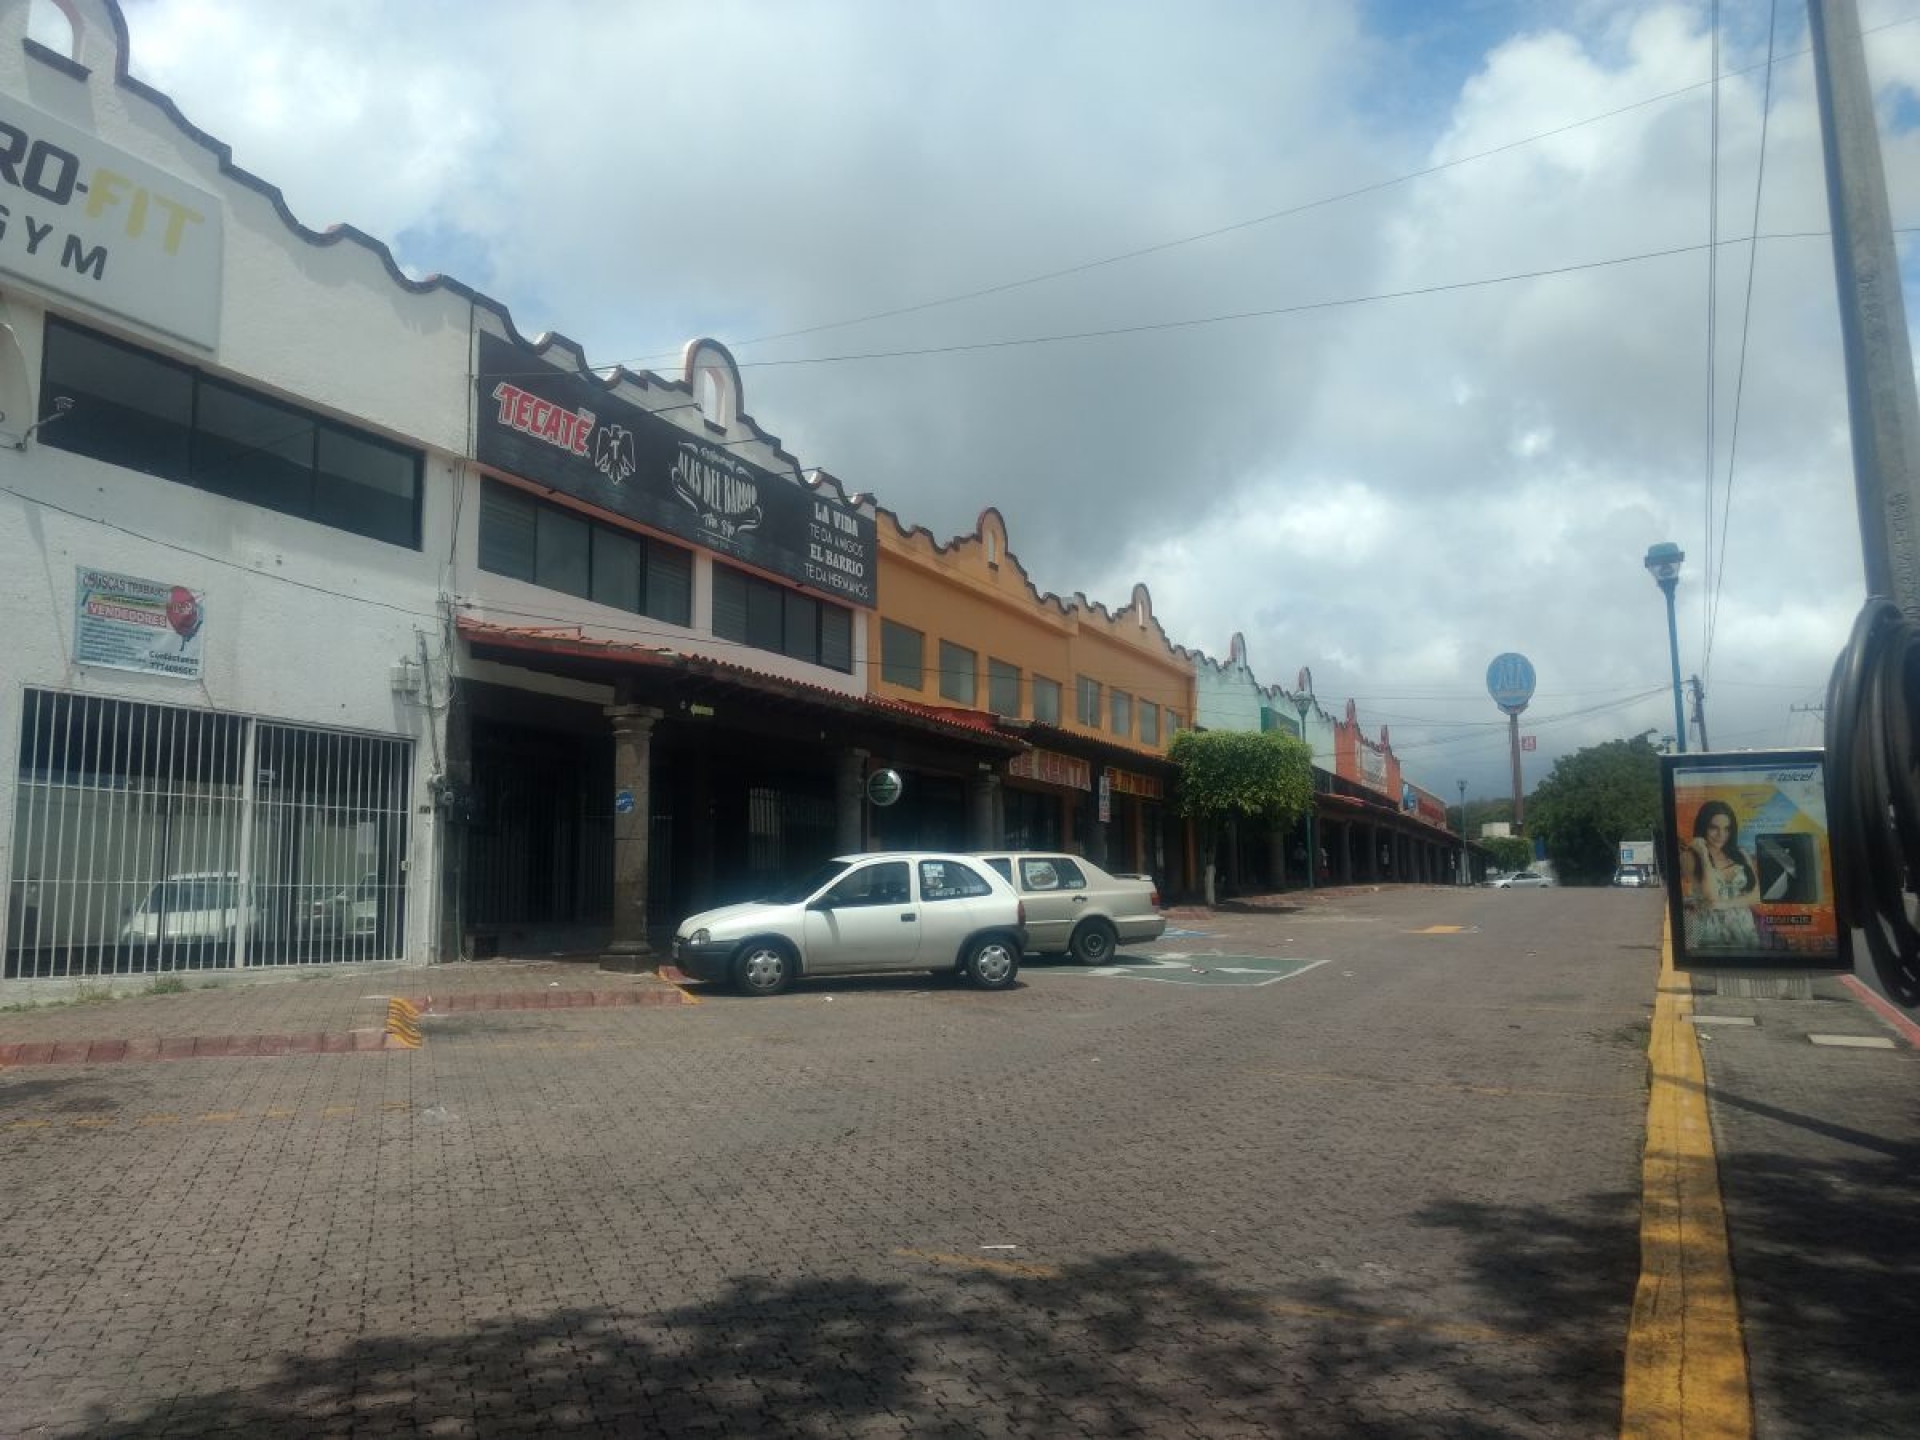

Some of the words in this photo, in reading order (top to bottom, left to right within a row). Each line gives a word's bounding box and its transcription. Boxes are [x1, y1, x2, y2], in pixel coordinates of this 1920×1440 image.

[493, 382, 595, 457] TECATE
[809, 522, 821, 540] TE
[821, 527, 833, 544] DA
[815, 501, 830, 524] LA
[833, 510, 859, 537] VIDA
[810, 543, 823, 562] EL
[825, 549, 864, 577] BARRIO
[804, 562, 815, 579] TE
[815, 567, 827, 583] DA
[828, 570, 869, 599] HERMANOS
[89, 601, 167, 628] VENDEDORES
